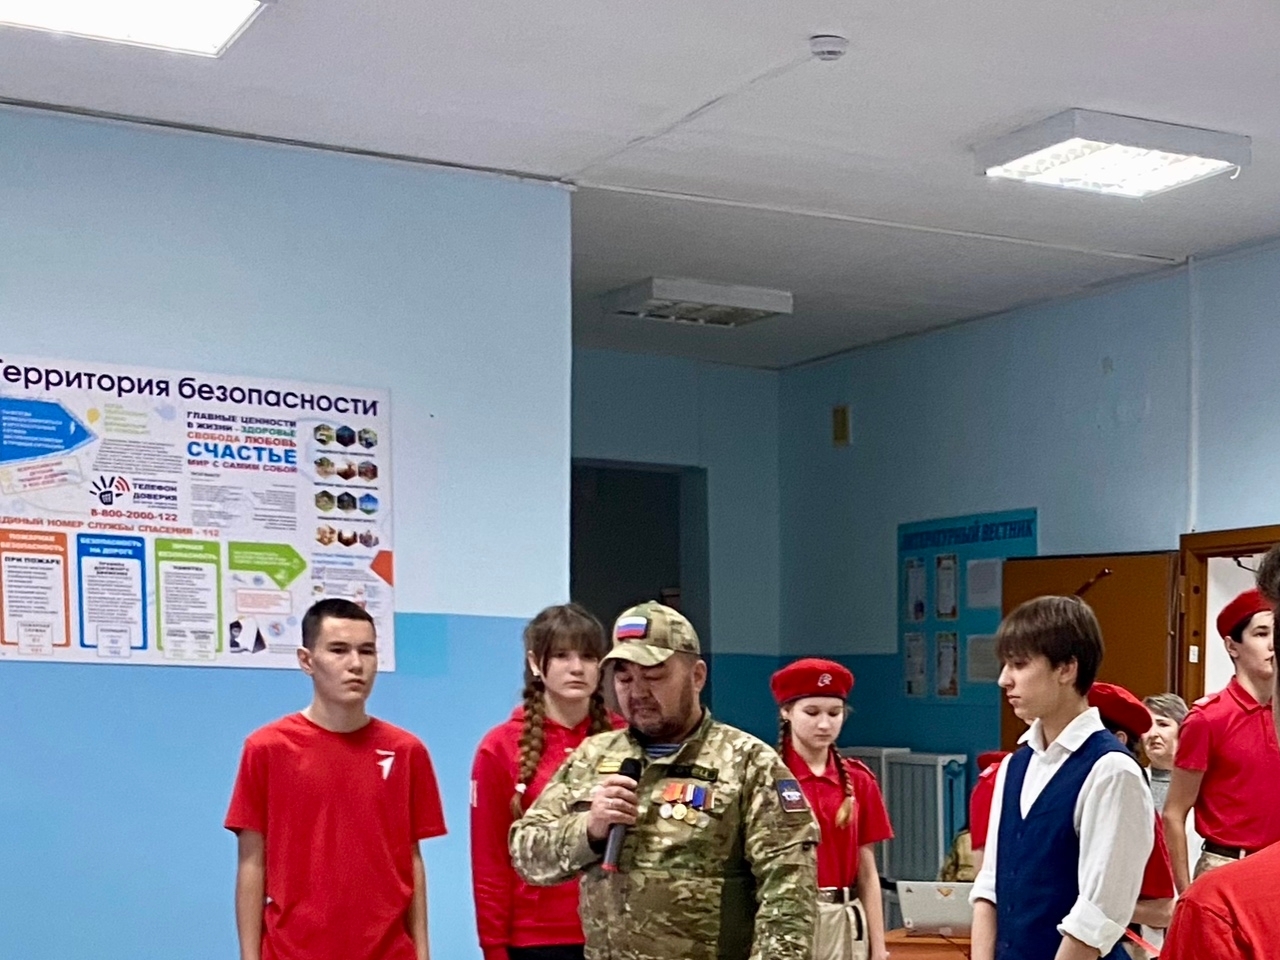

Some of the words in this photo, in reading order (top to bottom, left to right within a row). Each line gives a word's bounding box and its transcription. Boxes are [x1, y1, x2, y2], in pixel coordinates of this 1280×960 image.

[0, 358, 170, 397] ерритория
[178, 377, 380, 417] безопасности
[187, 411, 237, 423] ГЛАВНЫЕ
[241, 416, 297, 428] ЦЕННОСТИ
[187, 421, 194, 429] В
[196, 422, 233, 432] ЖИЗНИ
[240, 425, 297, 437] ЗДОРОВЬЕ
[187, 431, 240, 443] СВОБОДА
[244, 436, 297, 448] ЛЮБОВЬ
[187, 441, 297, 465] СЧАСТЬЕ
[187, 459, 210, 468] МИР
[212, 460, 219, 468] С
[222, 461, 260, 471] САМИМ
[262, 462, 298, 473] СОБОЙ
[132, 482, 177, 492] ТЕЛЕФОН
[132, 492, 178, 501] ДОВЕРИЯ
[91, 508, 178, 521] 8-800-2000-122
[0, 516, 44, 526] ДИНЫЙ
[47, 519, 84, 528] НОМЕР
[87, 521, 134, 531] СЛУЖБЫ
[138, 524, 193, 535] СПАСЕНИЯ
[202, 529, 220, 537] 112
[24, 557, 61, 565] ПОЖАРЕ
